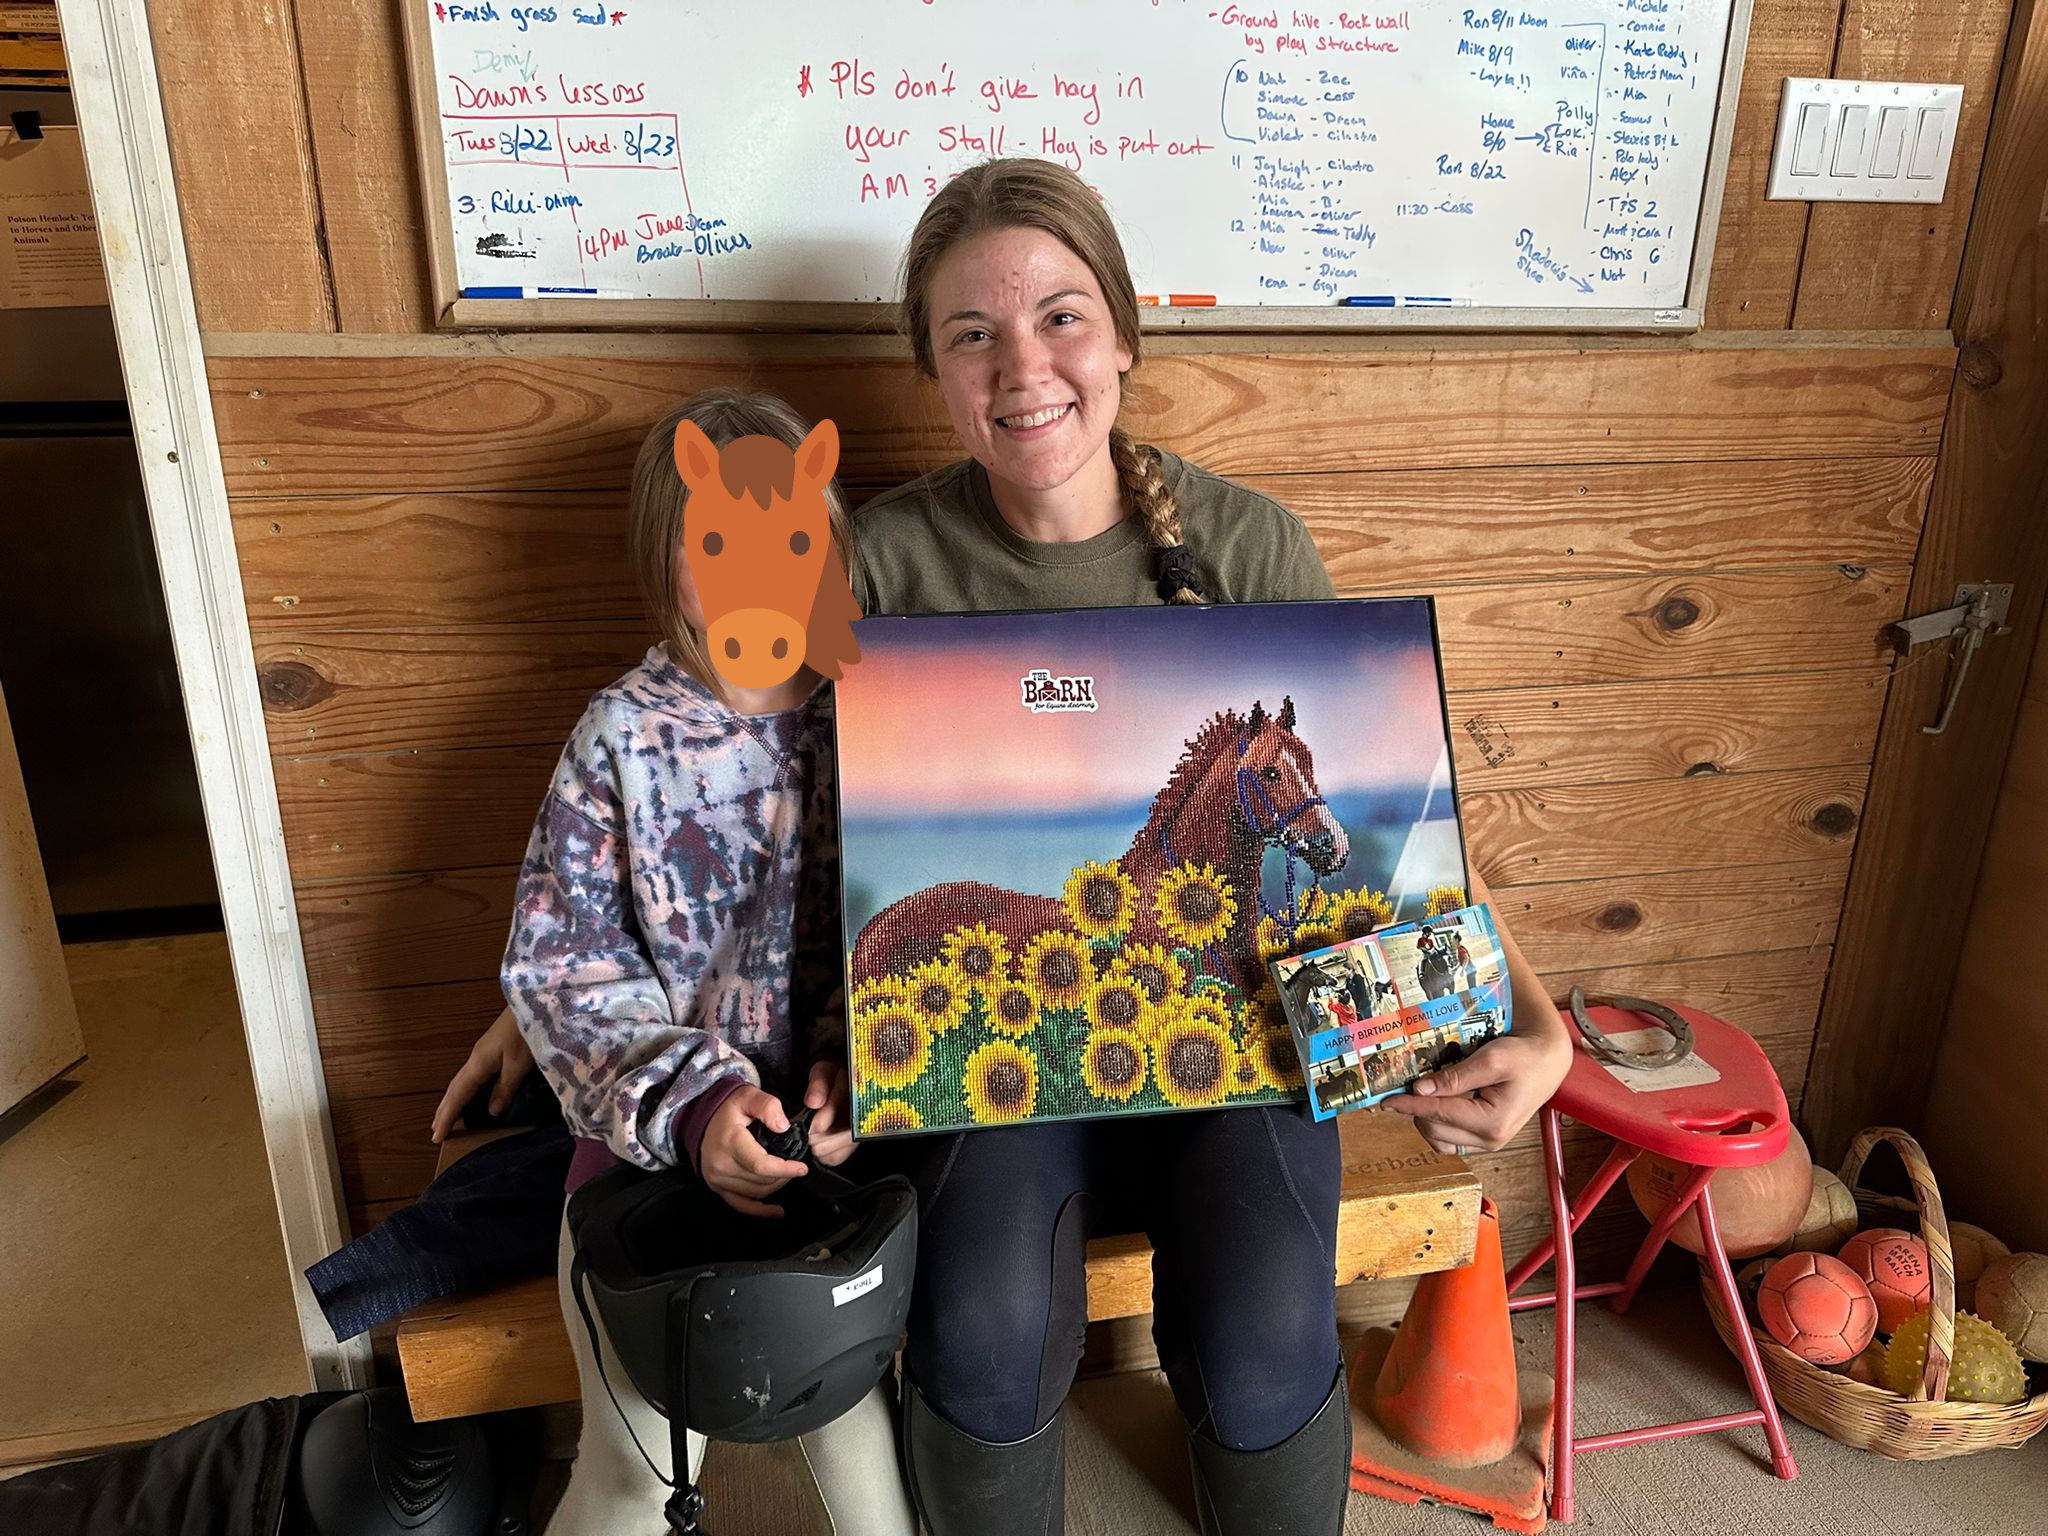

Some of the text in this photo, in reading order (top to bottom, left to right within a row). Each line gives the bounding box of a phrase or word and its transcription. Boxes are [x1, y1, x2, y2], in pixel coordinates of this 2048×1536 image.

[510, 6, 558, 32] grass
[1221, 5, 1278, 28] Ground
[1339, 13, 1372, 30] Rock
[1376, 11, 1410, 31] wall
[1462, 9, 1490, 29] Ron
[1626, 19, 1667, 32] Connie
[1244, 33, 1265, 54] by
[1276, 34, 1308, 57] play
[1457, 38, 1514, 66] Mike 8/9
[448, 70, 548, 109] Dawn's
[828, 59, 1145, 126] Pls don't give hay in
[1256, 107, 1297, 122] Dawn
[623, 122, 677, 164] 8/23
[844, 123, 911, 163] your
[1041, 126, 1082, 172] Hay
[1088, 130, 1108, 156] is
[1118, 129, 1160, 161] put
[1166, 134, 1216, 156] out
[1470, 159, 1507, 181] 8/22
[860, 173, 909, 204] AM
[7, 215, 38, 223] Poison
[39, 213, 80, 222] Hemlock:
[1396, 204, 1429, 216] 11:30
[21, 225, 54, 234] Horses
[54, 224, 71, 233] and
[1230, 219, 1246, 232] 12
[13, 236, 50, 245] Animals
[1599, 245, 1633, 261] Chris
[1031, 672, 1048, 681] THE
[1324, 1033, 1355, 1051] HAPPY
[1356, 1018, 1404, 1042] BIRTHDAY
[1435, 1003, 1460, 1018] LOVE
[1884, 1256, 1903, 1278] BALL
[1889, 1249, 1914, 1277] MATCH
[1894, 1244, 1923, 1276] ARENA
